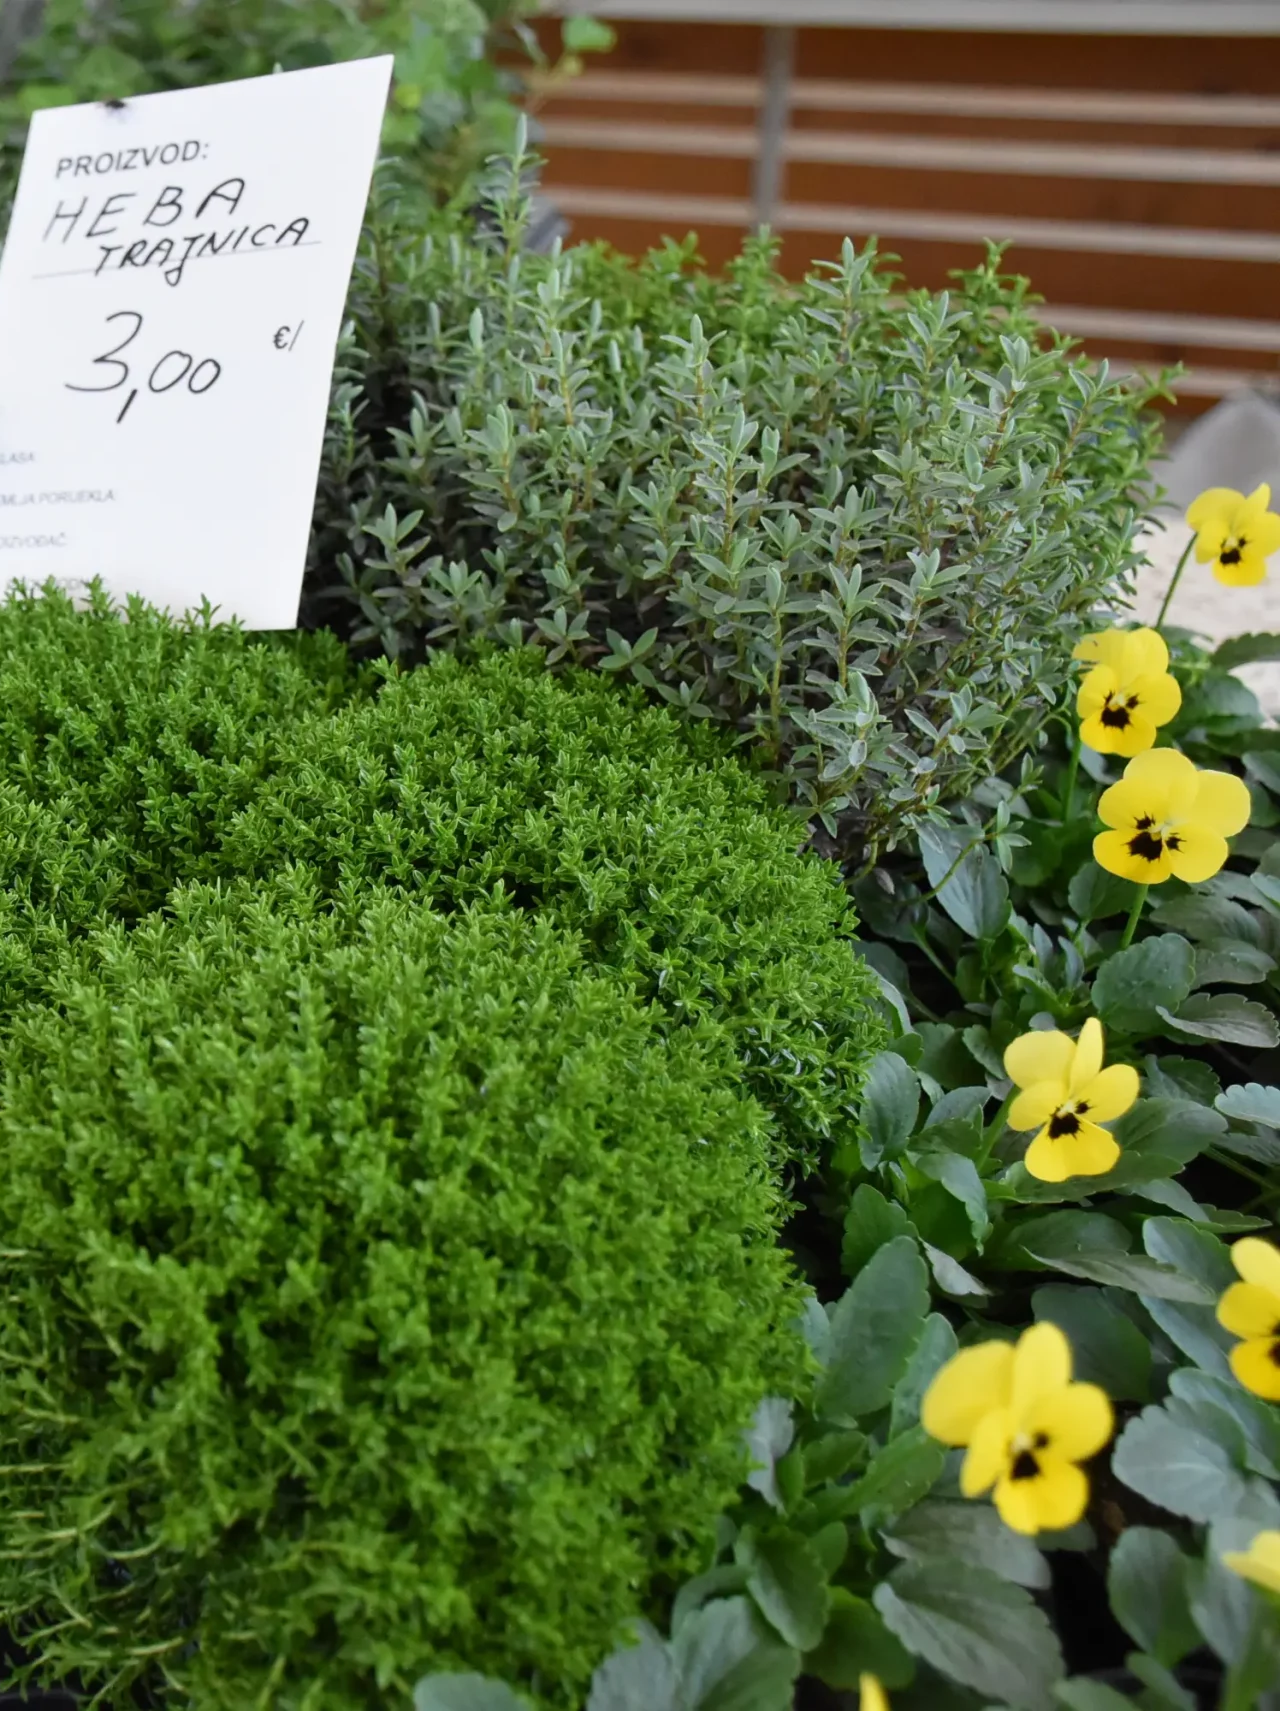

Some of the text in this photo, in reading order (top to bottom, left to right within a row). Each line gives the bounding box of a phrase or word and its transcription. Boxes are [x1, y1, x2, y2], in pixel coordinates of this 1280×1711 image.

[56, 140, 210, 178] PROIZVOD:
[42, 177, 246, 244] HEBA
[94, 217, 309, 287] TRAJNICA
[65, 311, 221, 424] 3,00
